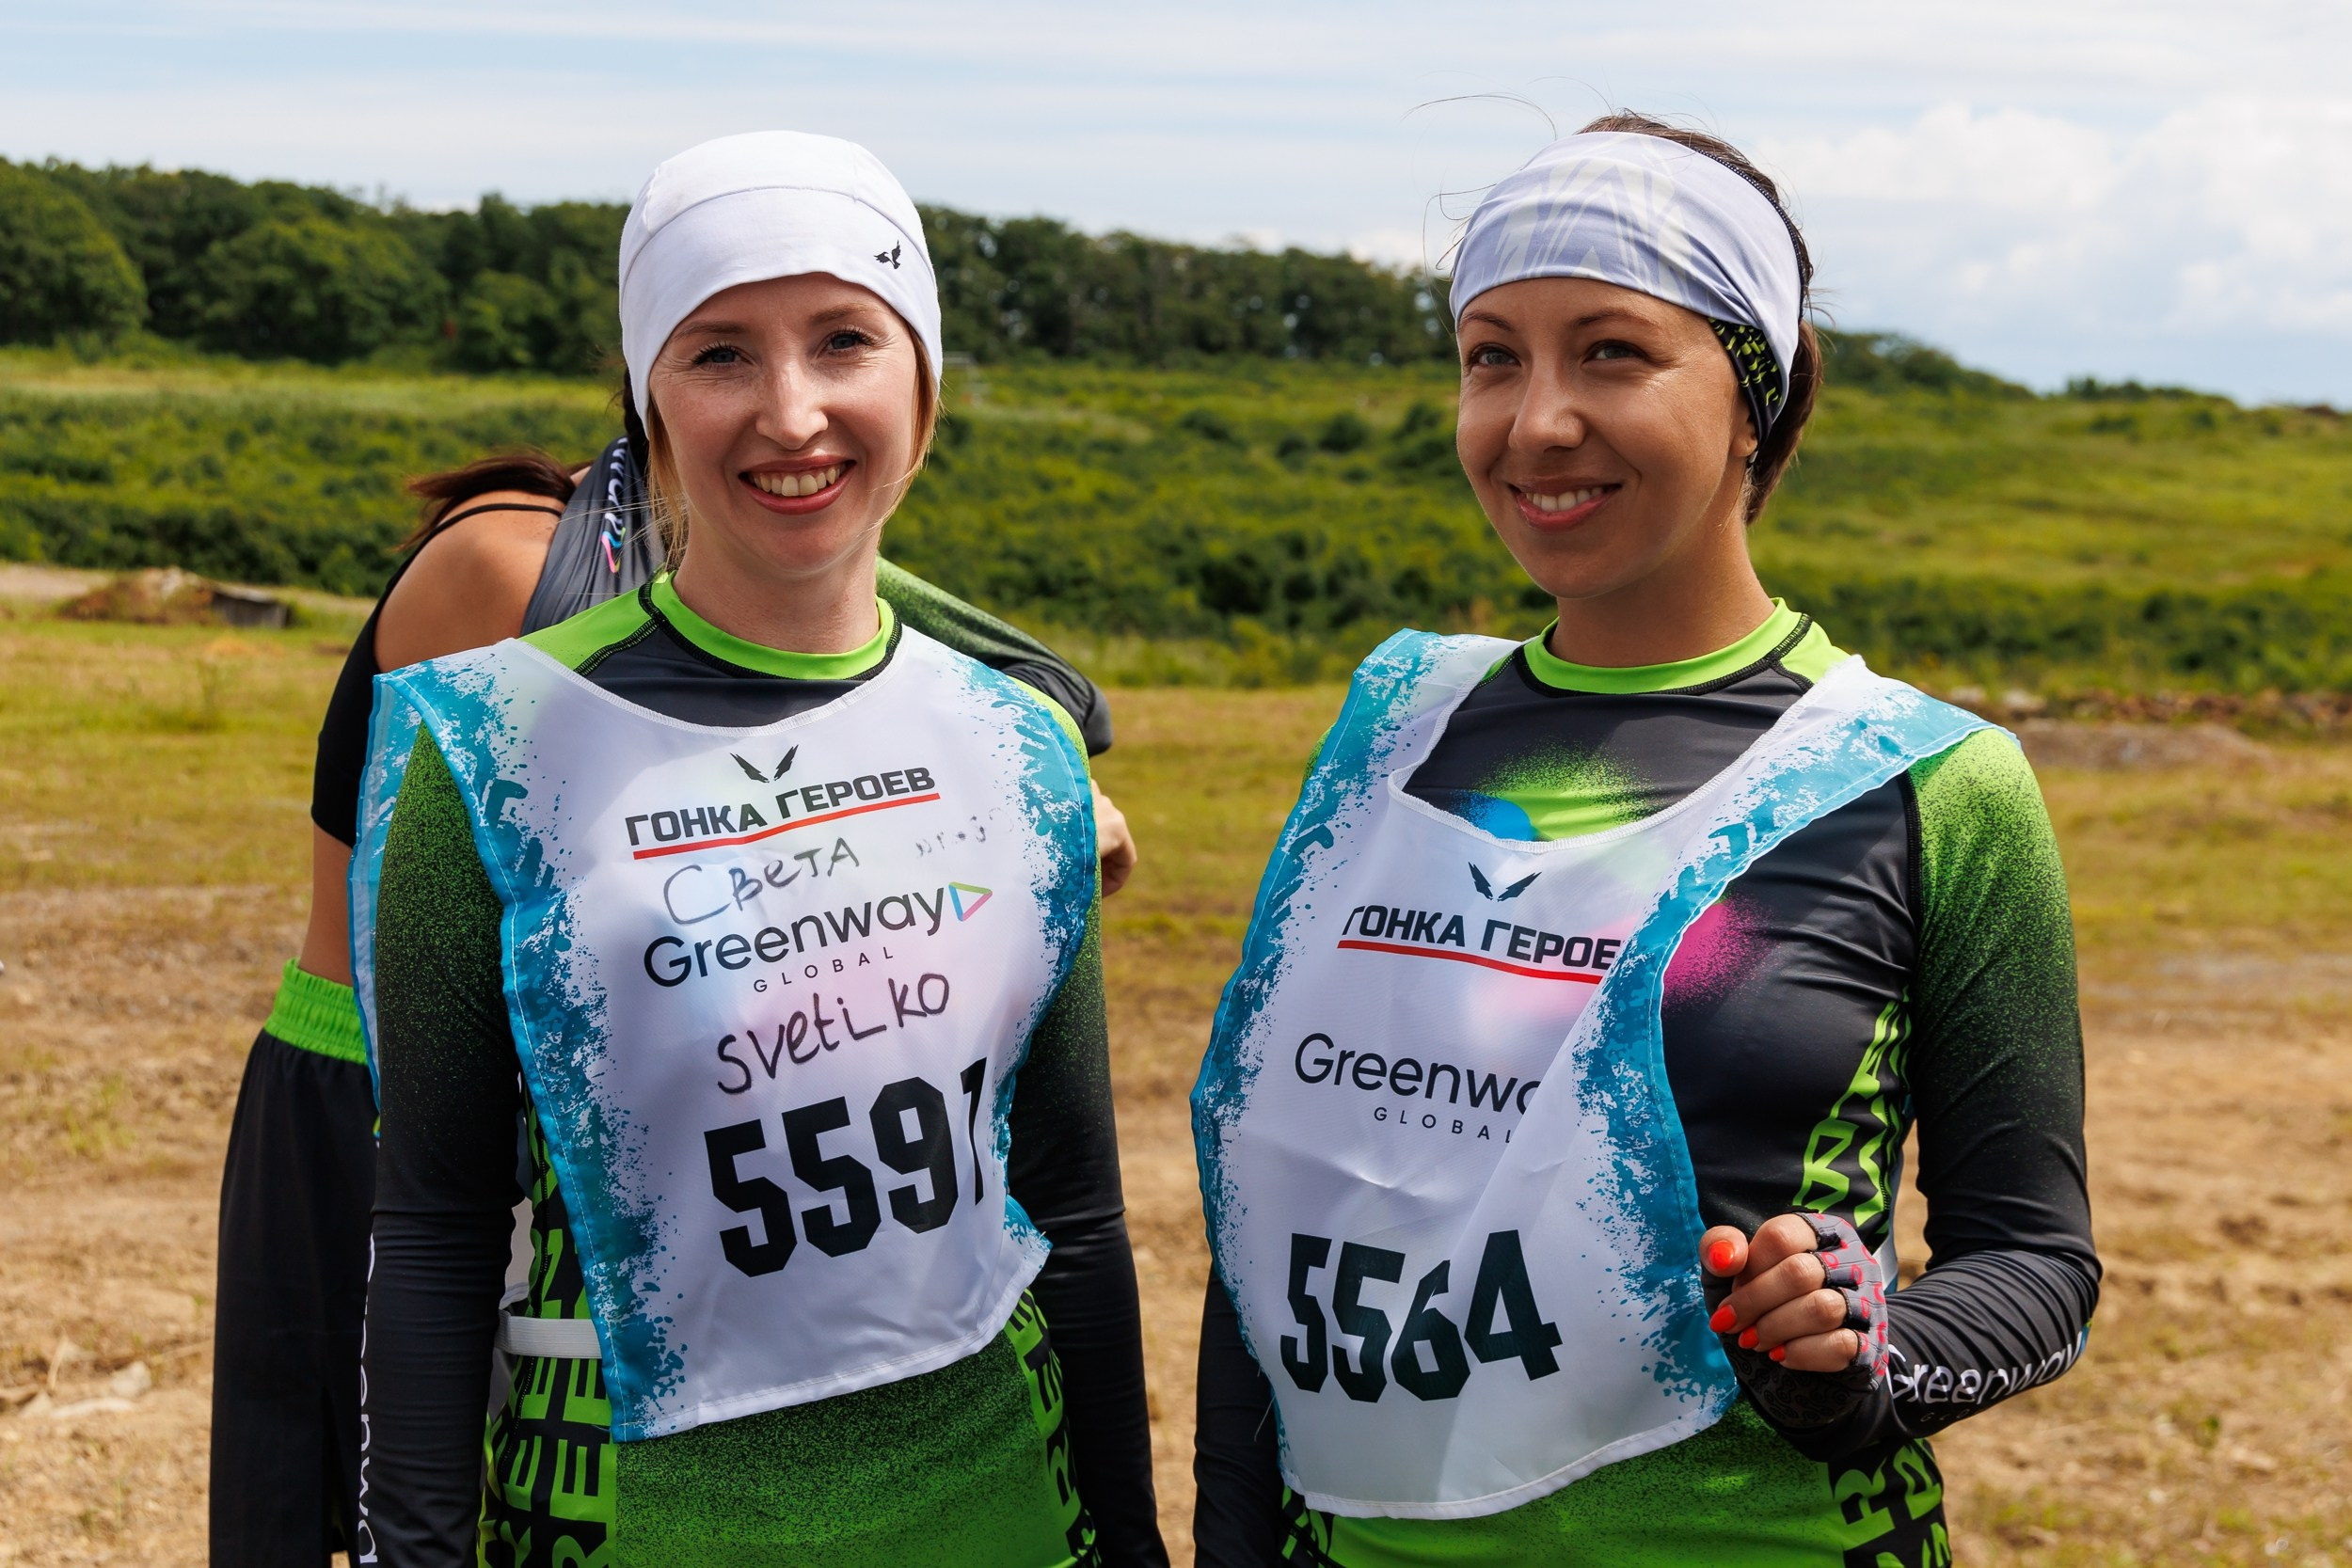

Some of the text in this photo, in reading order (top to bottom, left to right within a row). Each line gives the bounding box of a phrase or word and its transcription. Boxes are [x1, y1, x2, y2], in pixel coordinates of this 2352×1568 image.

[625, 767, 935, 847] ГОНКА ГЕРОЕВ
[644, 887, 945, 988] Greenway
[753, 946, 895, 993] GLOBAL
[1342, 904, 1627, 971] ГОНКА ГЕРОЕ
[704, 1056, 988, 1277] 5591
[1279, 1229, 1564, 1403] 5564
